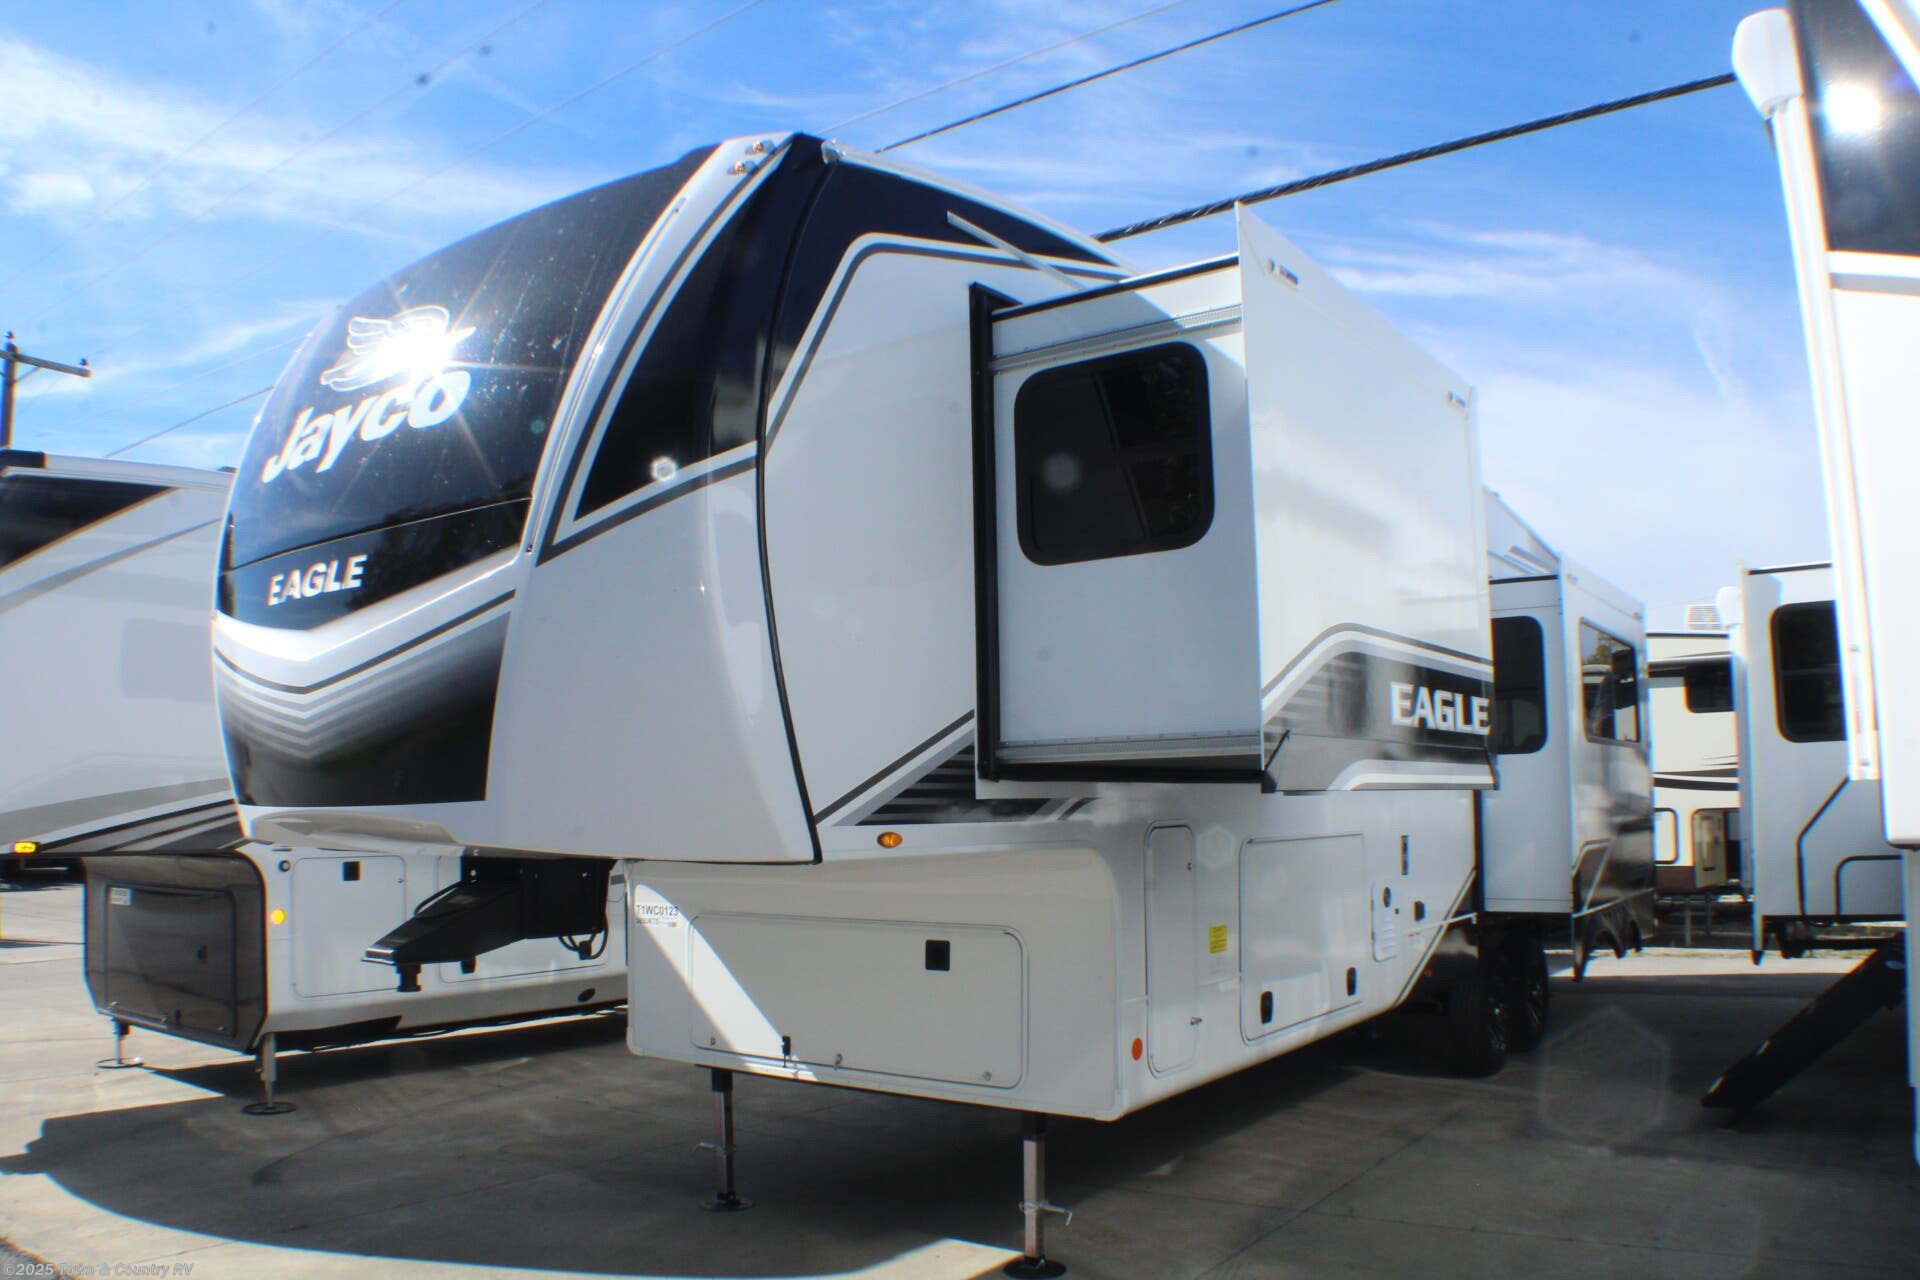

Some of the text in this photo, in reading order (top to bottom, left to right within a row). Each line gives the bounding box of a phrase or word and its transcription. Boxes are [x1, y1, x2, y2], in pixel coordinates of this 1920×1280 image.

[260, 369, 471, 484] Jayco
[266, 554, 368, 606] EAGLE
[1390, 681, 1492, 736] EAGLE
